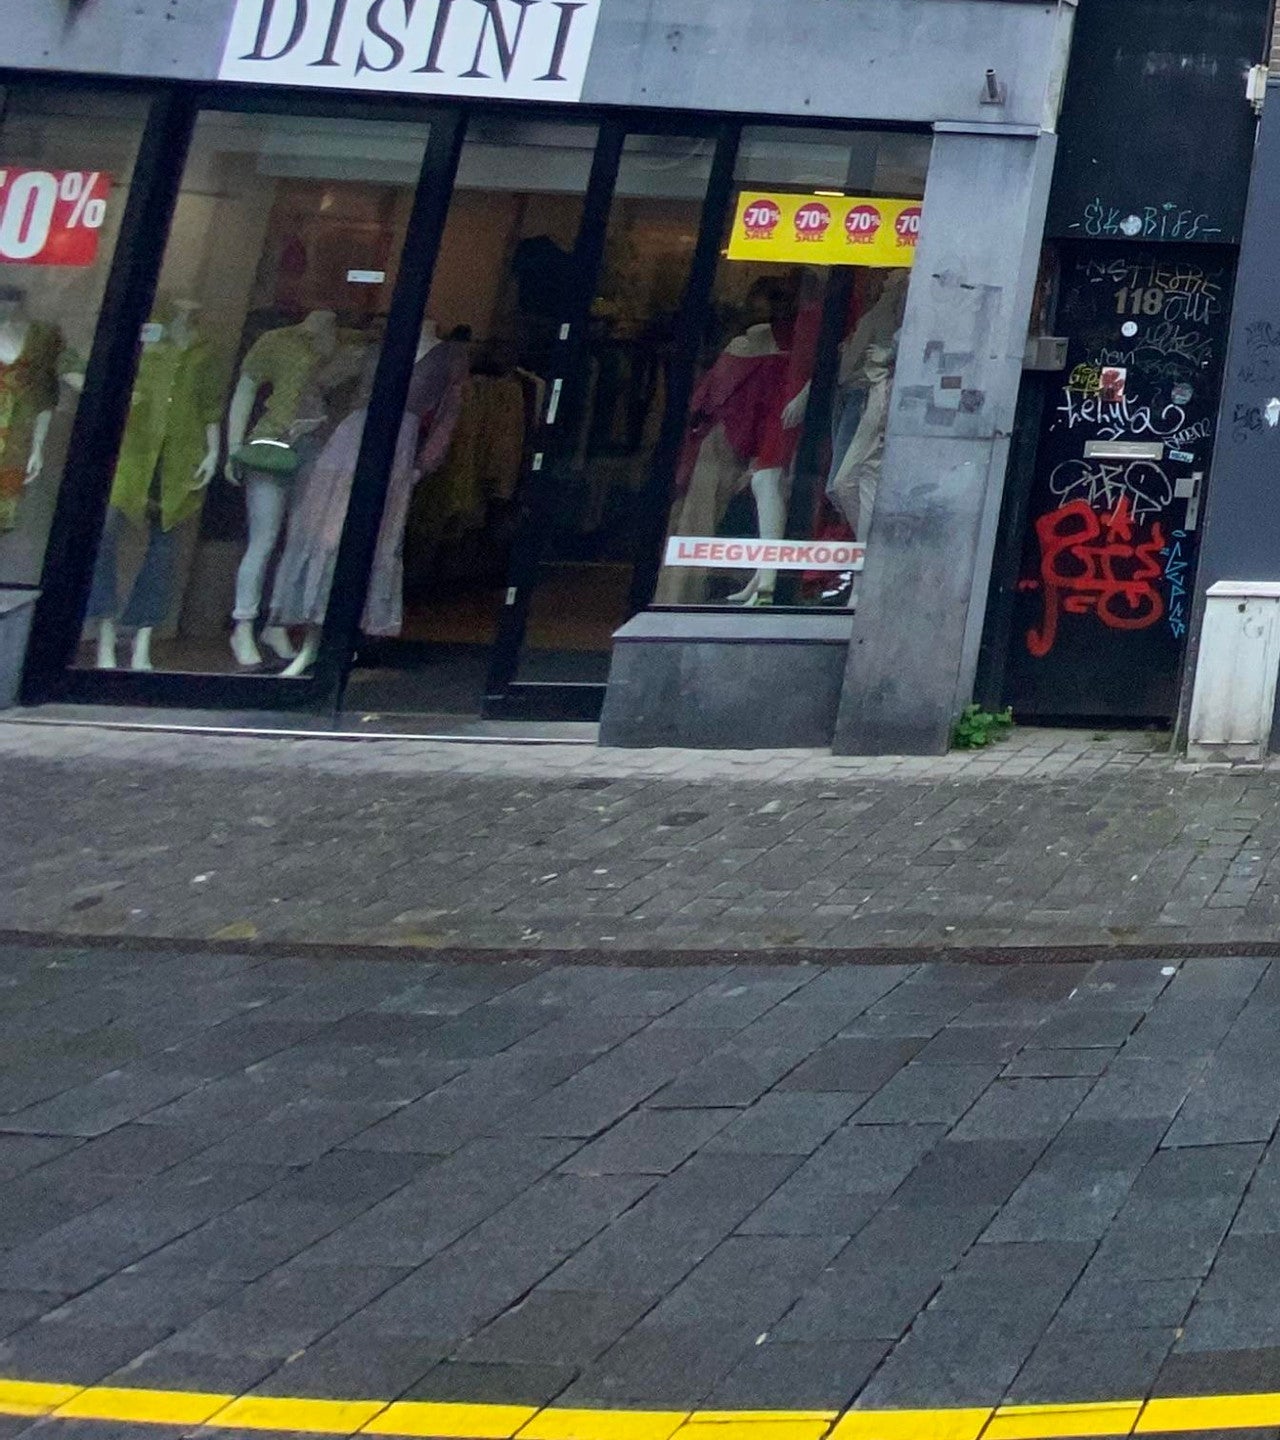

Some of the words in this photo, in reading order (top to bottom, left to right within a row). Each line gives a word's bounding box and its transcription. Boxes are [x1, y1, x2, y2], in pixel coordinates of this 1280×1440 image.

[0, 170, 106, 259] 0%
[746, 208, 780, 226] -70%
[796, 210, 830, 228] -70%
[846, 212, 881, 230] -70%
[897, 215, 919, 233] -70
[896, 236, 918, 247] SAL
[1114, 287, 1164, 315] 118
